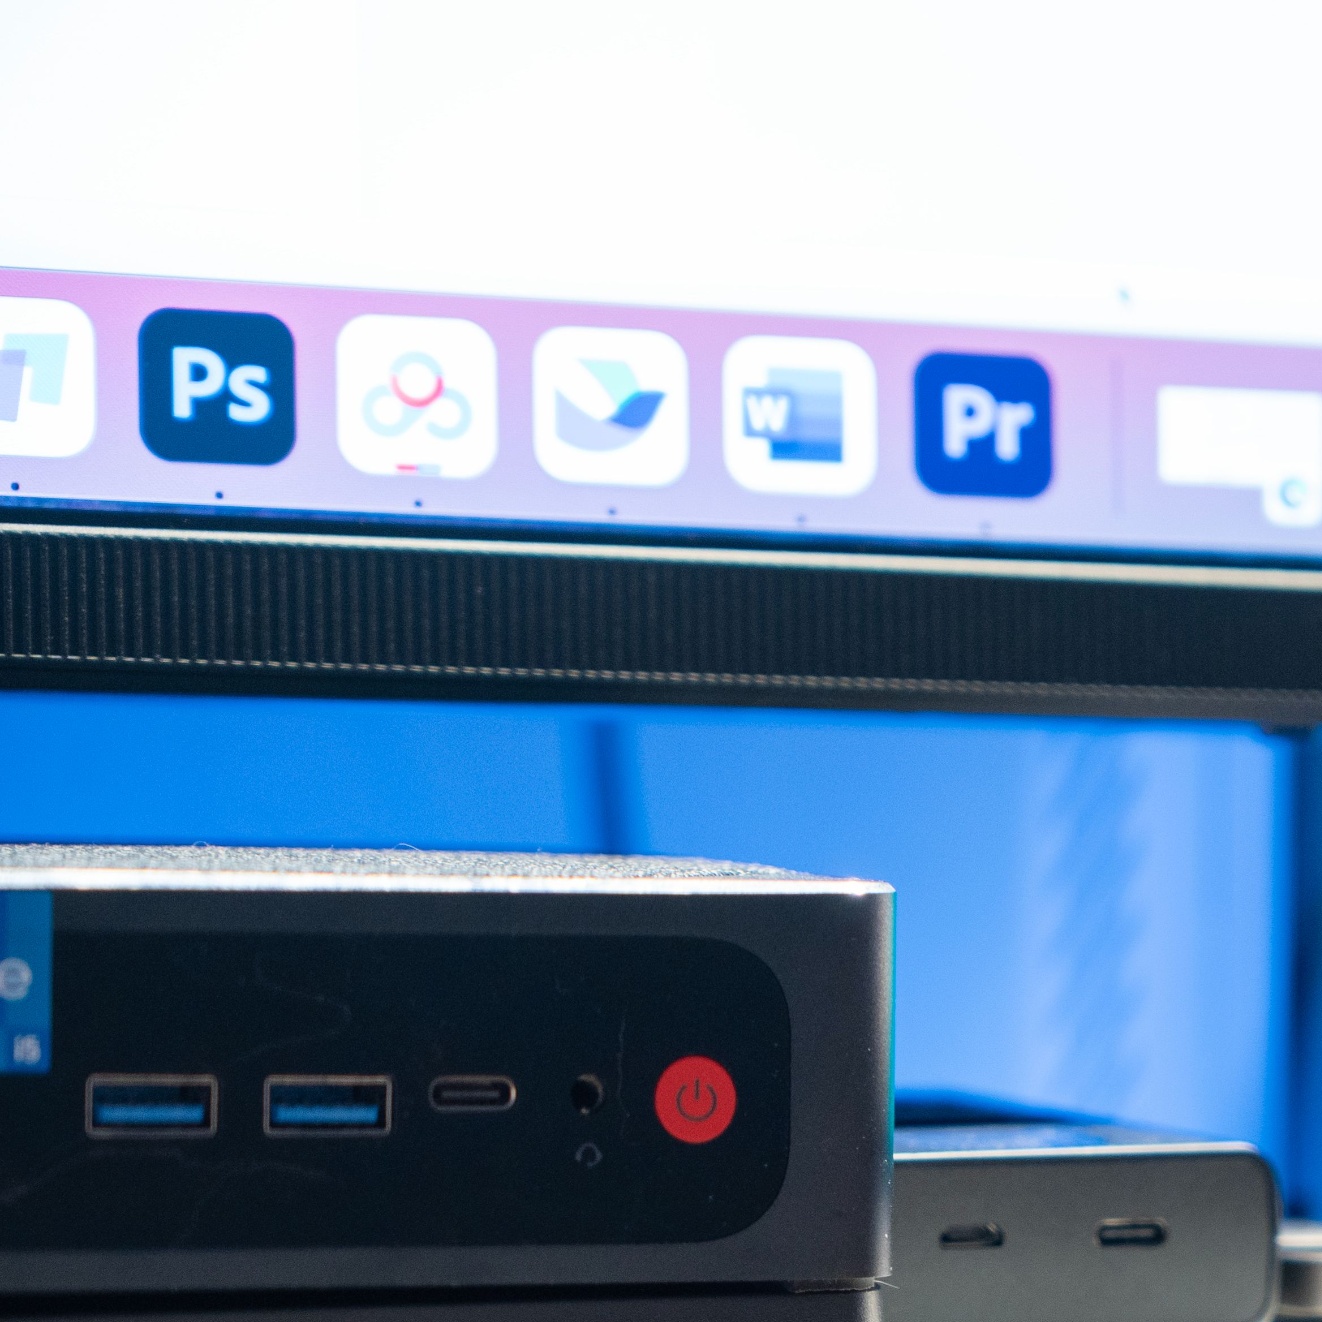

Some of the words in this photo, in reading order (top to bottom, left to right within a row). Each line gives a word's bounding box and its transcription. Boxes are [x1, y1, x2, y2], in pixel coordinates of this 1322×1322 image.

[171, 346, 271, 423] Ps
[746, 393, 789, 432] W
[942, 382, 1034, 461] Pr
